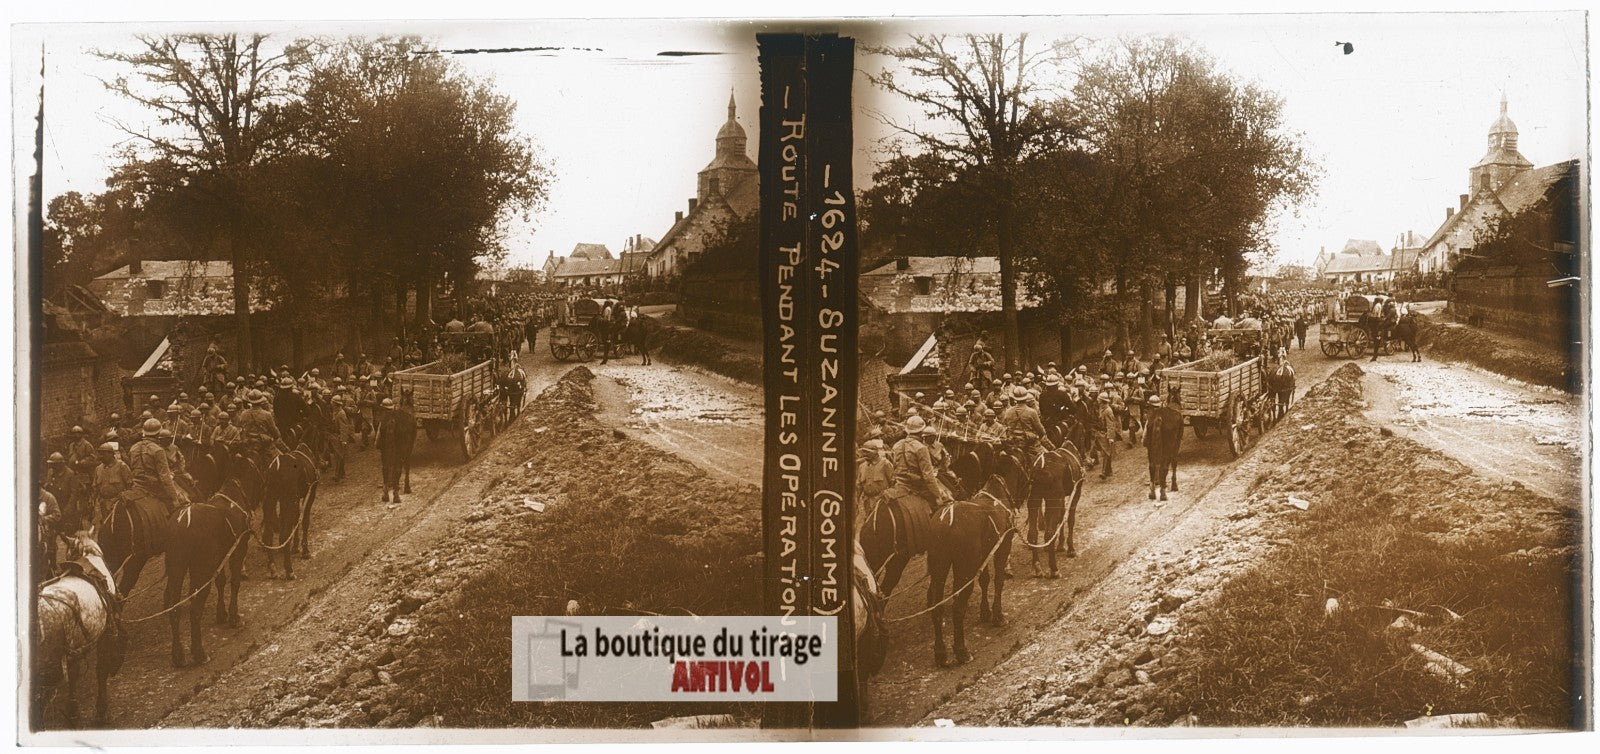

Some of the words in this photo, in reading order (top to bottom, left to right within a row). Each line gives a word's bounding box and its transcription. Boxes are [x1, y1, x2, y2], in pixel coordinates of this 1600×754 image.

[778, 243, 803, 383] PENDANT
[779, 395, 800, 445] LES
[819, 308, 843, 477] SUZANNE
